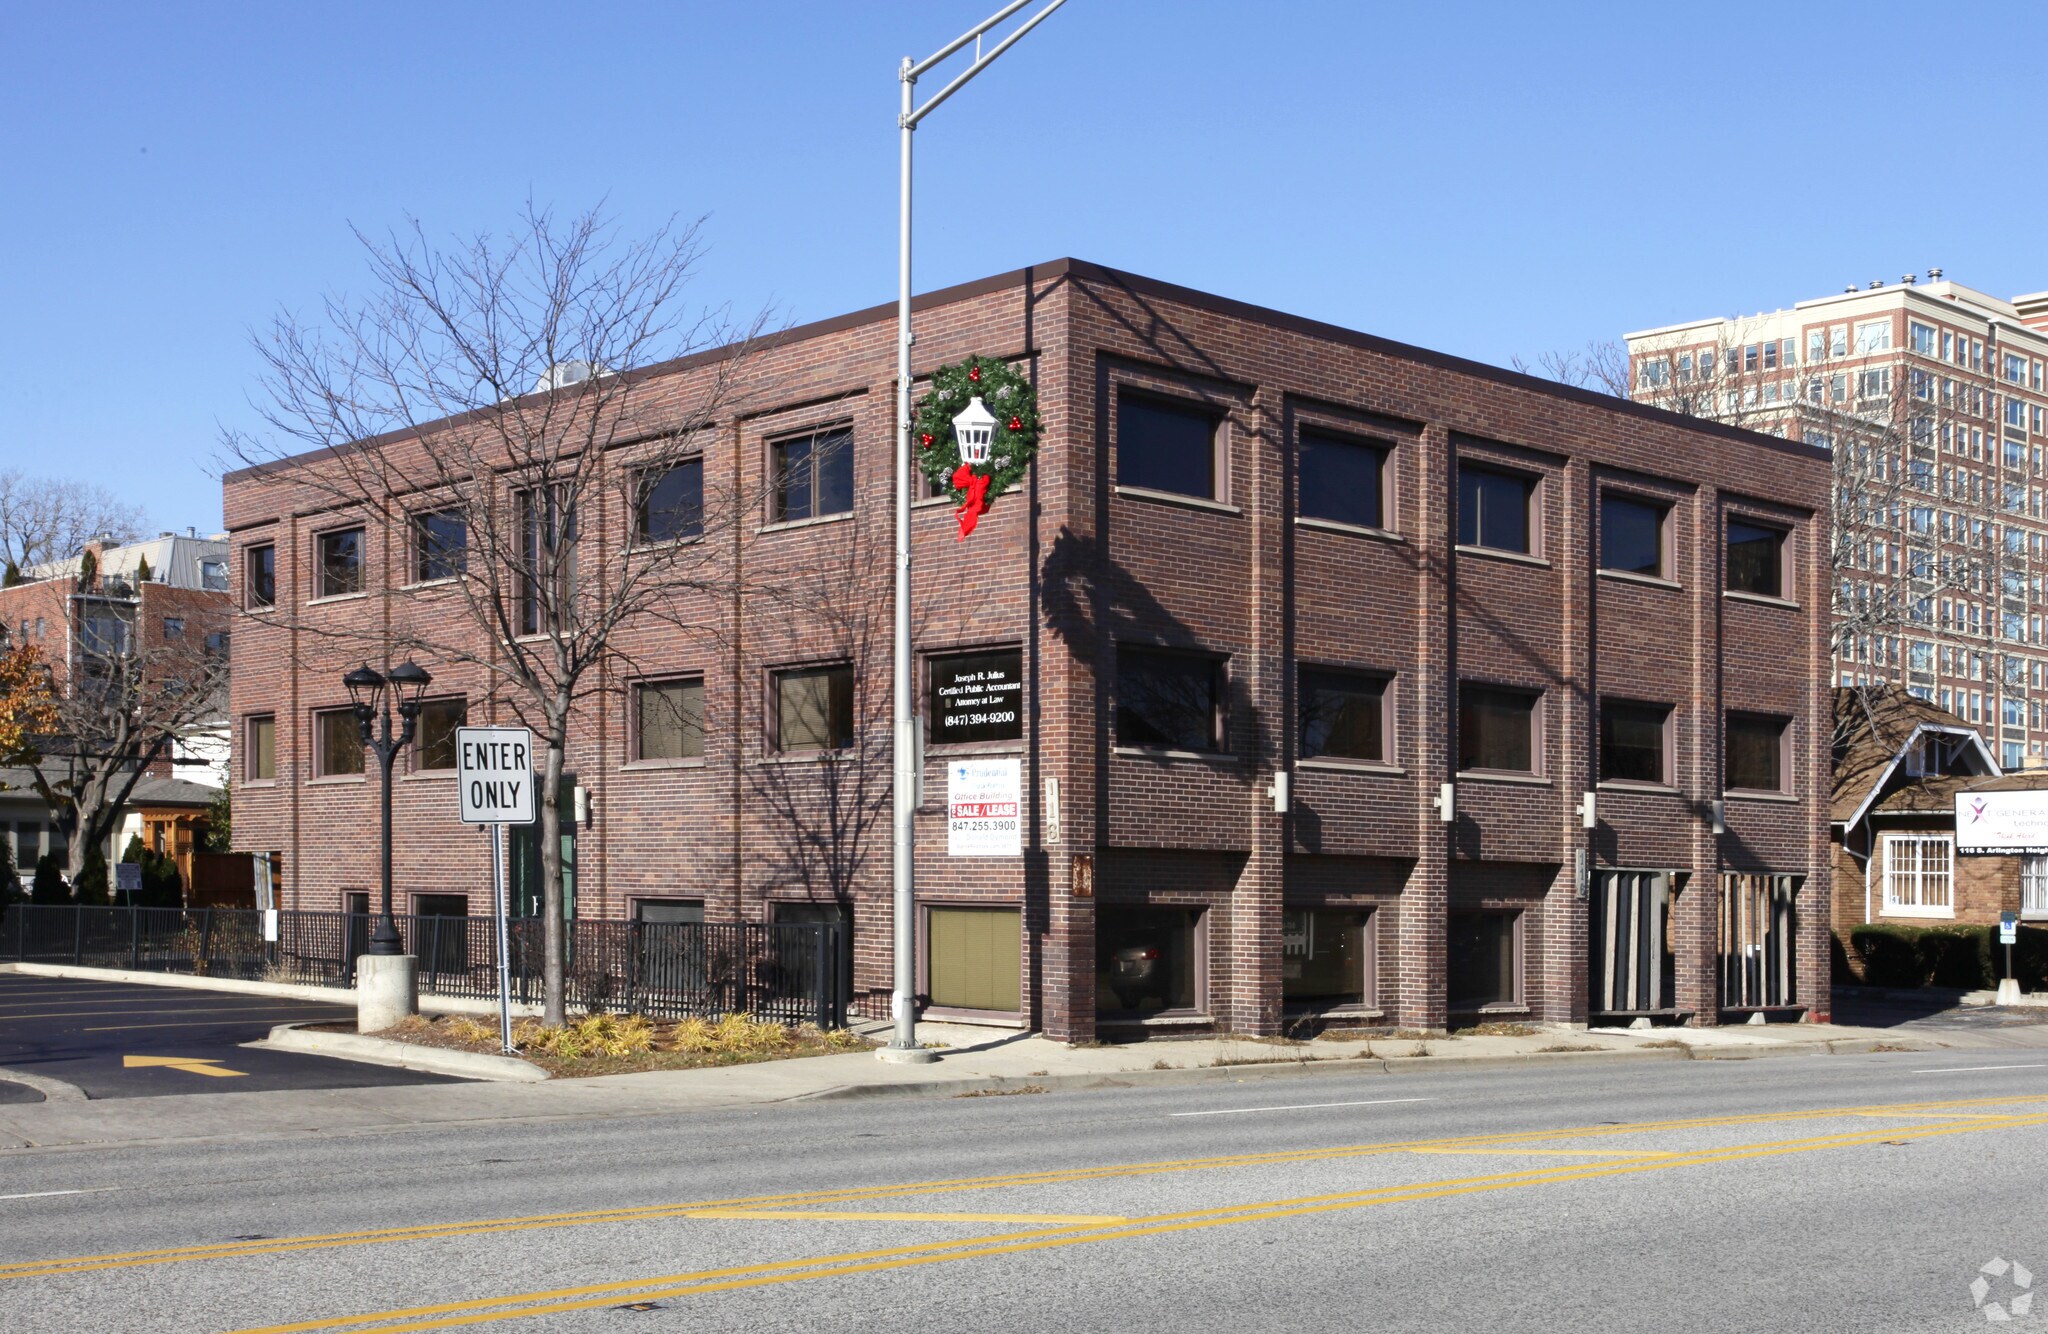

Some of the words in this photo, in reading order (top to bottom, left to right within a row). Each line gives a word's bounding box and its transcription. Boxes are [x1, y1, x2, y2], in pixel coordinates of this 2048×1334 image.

[954, 674, 976, 683] Joseph
[977, 672, 985, 680] R.
[987, 671, 1005, 680] Julius
[939, 686, 963, 696] Certified
[965, 685, 984, 694] Public
[986, 682, 1021, 692] Accountant
[955, 698, 980, 707] Attorney
[989, 695, 1004, 704] Law
[945, 714, 968, 727] (847)
[969, 711, 1015, 725] 394-9200
[463, 743, 526, 770] ENTER
[471, 780, 521, 809] ONLY
[954, 793, 977, 801] Office
[980, 792, 1013, 801] Building
[952, 820, 1016, 831] 847.255.3900
[1986, 847, 2025, 855] Arlington
